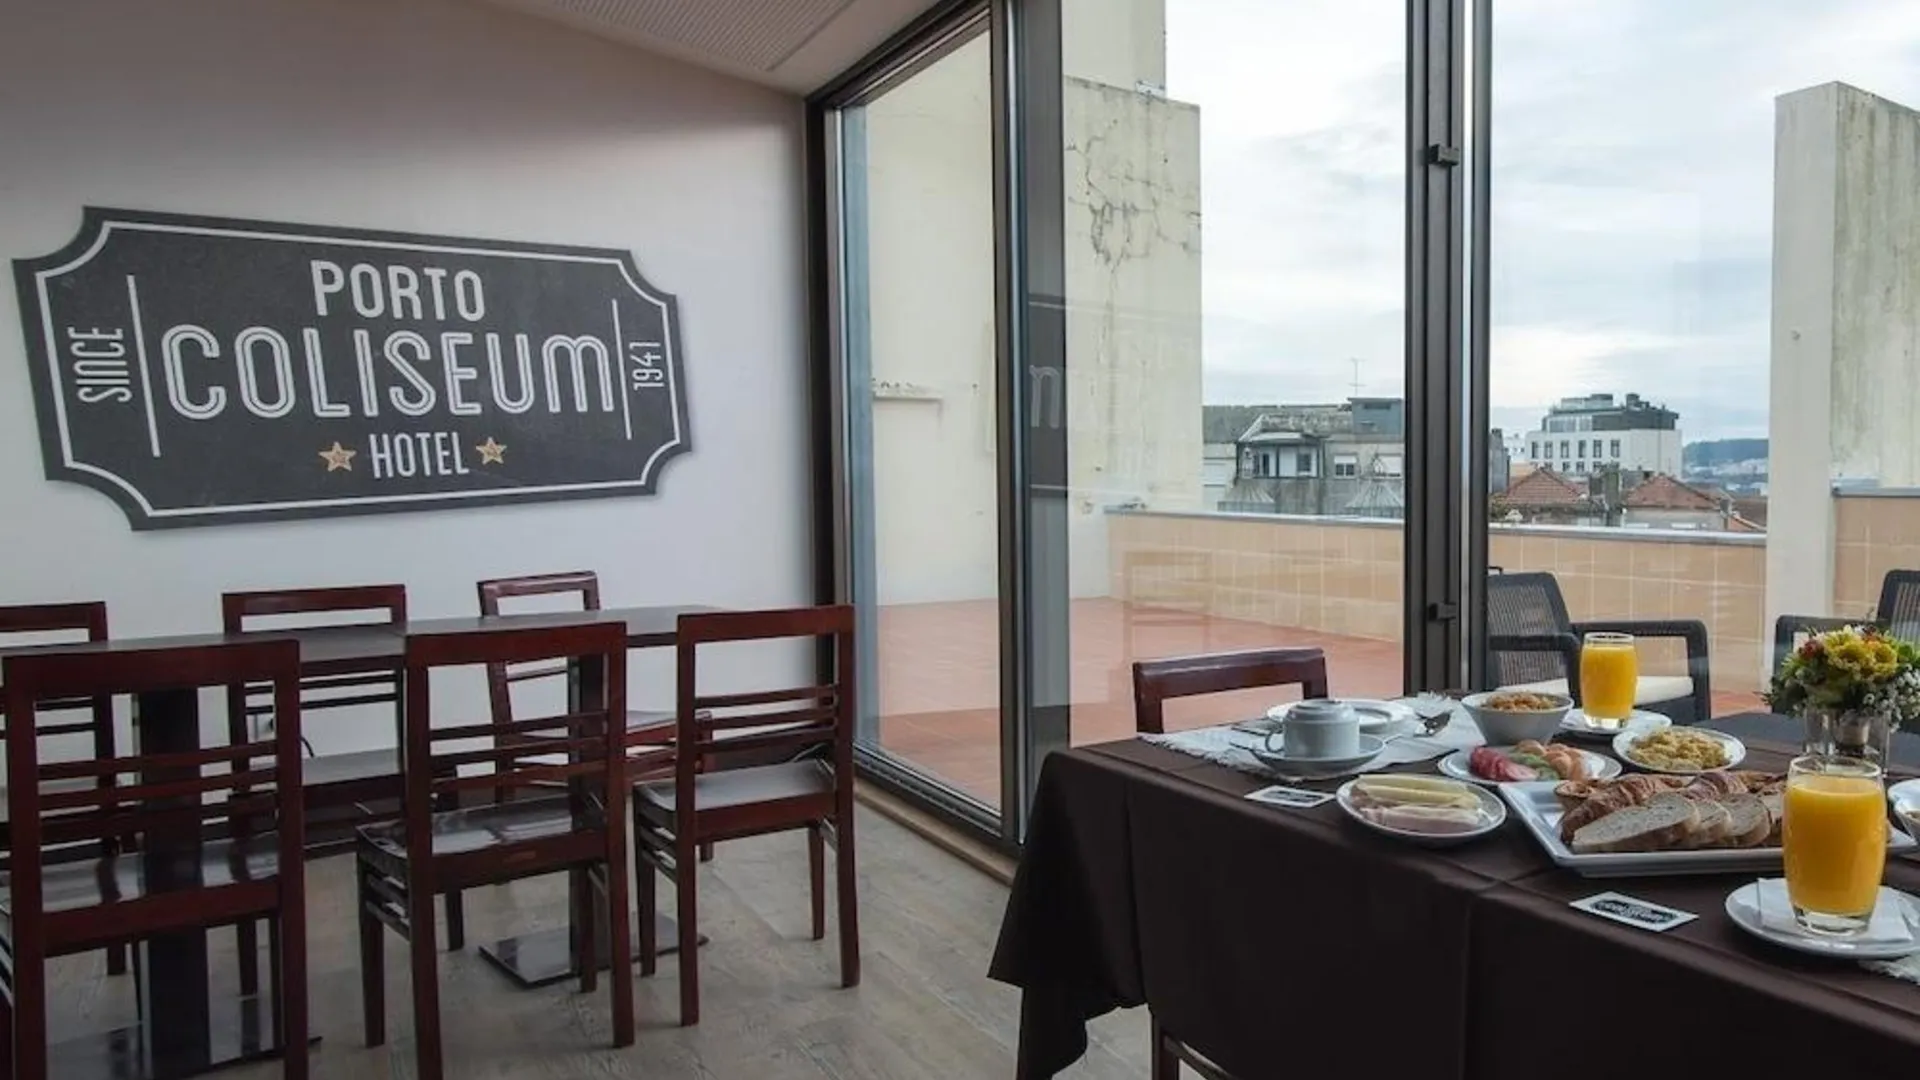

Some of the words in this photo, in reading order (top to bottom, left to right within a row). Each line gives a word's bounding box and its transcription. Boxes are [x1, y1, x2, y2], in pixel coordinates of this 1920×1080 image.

[310, 260, 486, 321] PORTO
[68, 327, 133, 403] SINCE
[162, 323, 614, 420] COLISEUM
[631, 342, 665, 391] 1941
[370, 432, 470, 478] HOTEL
